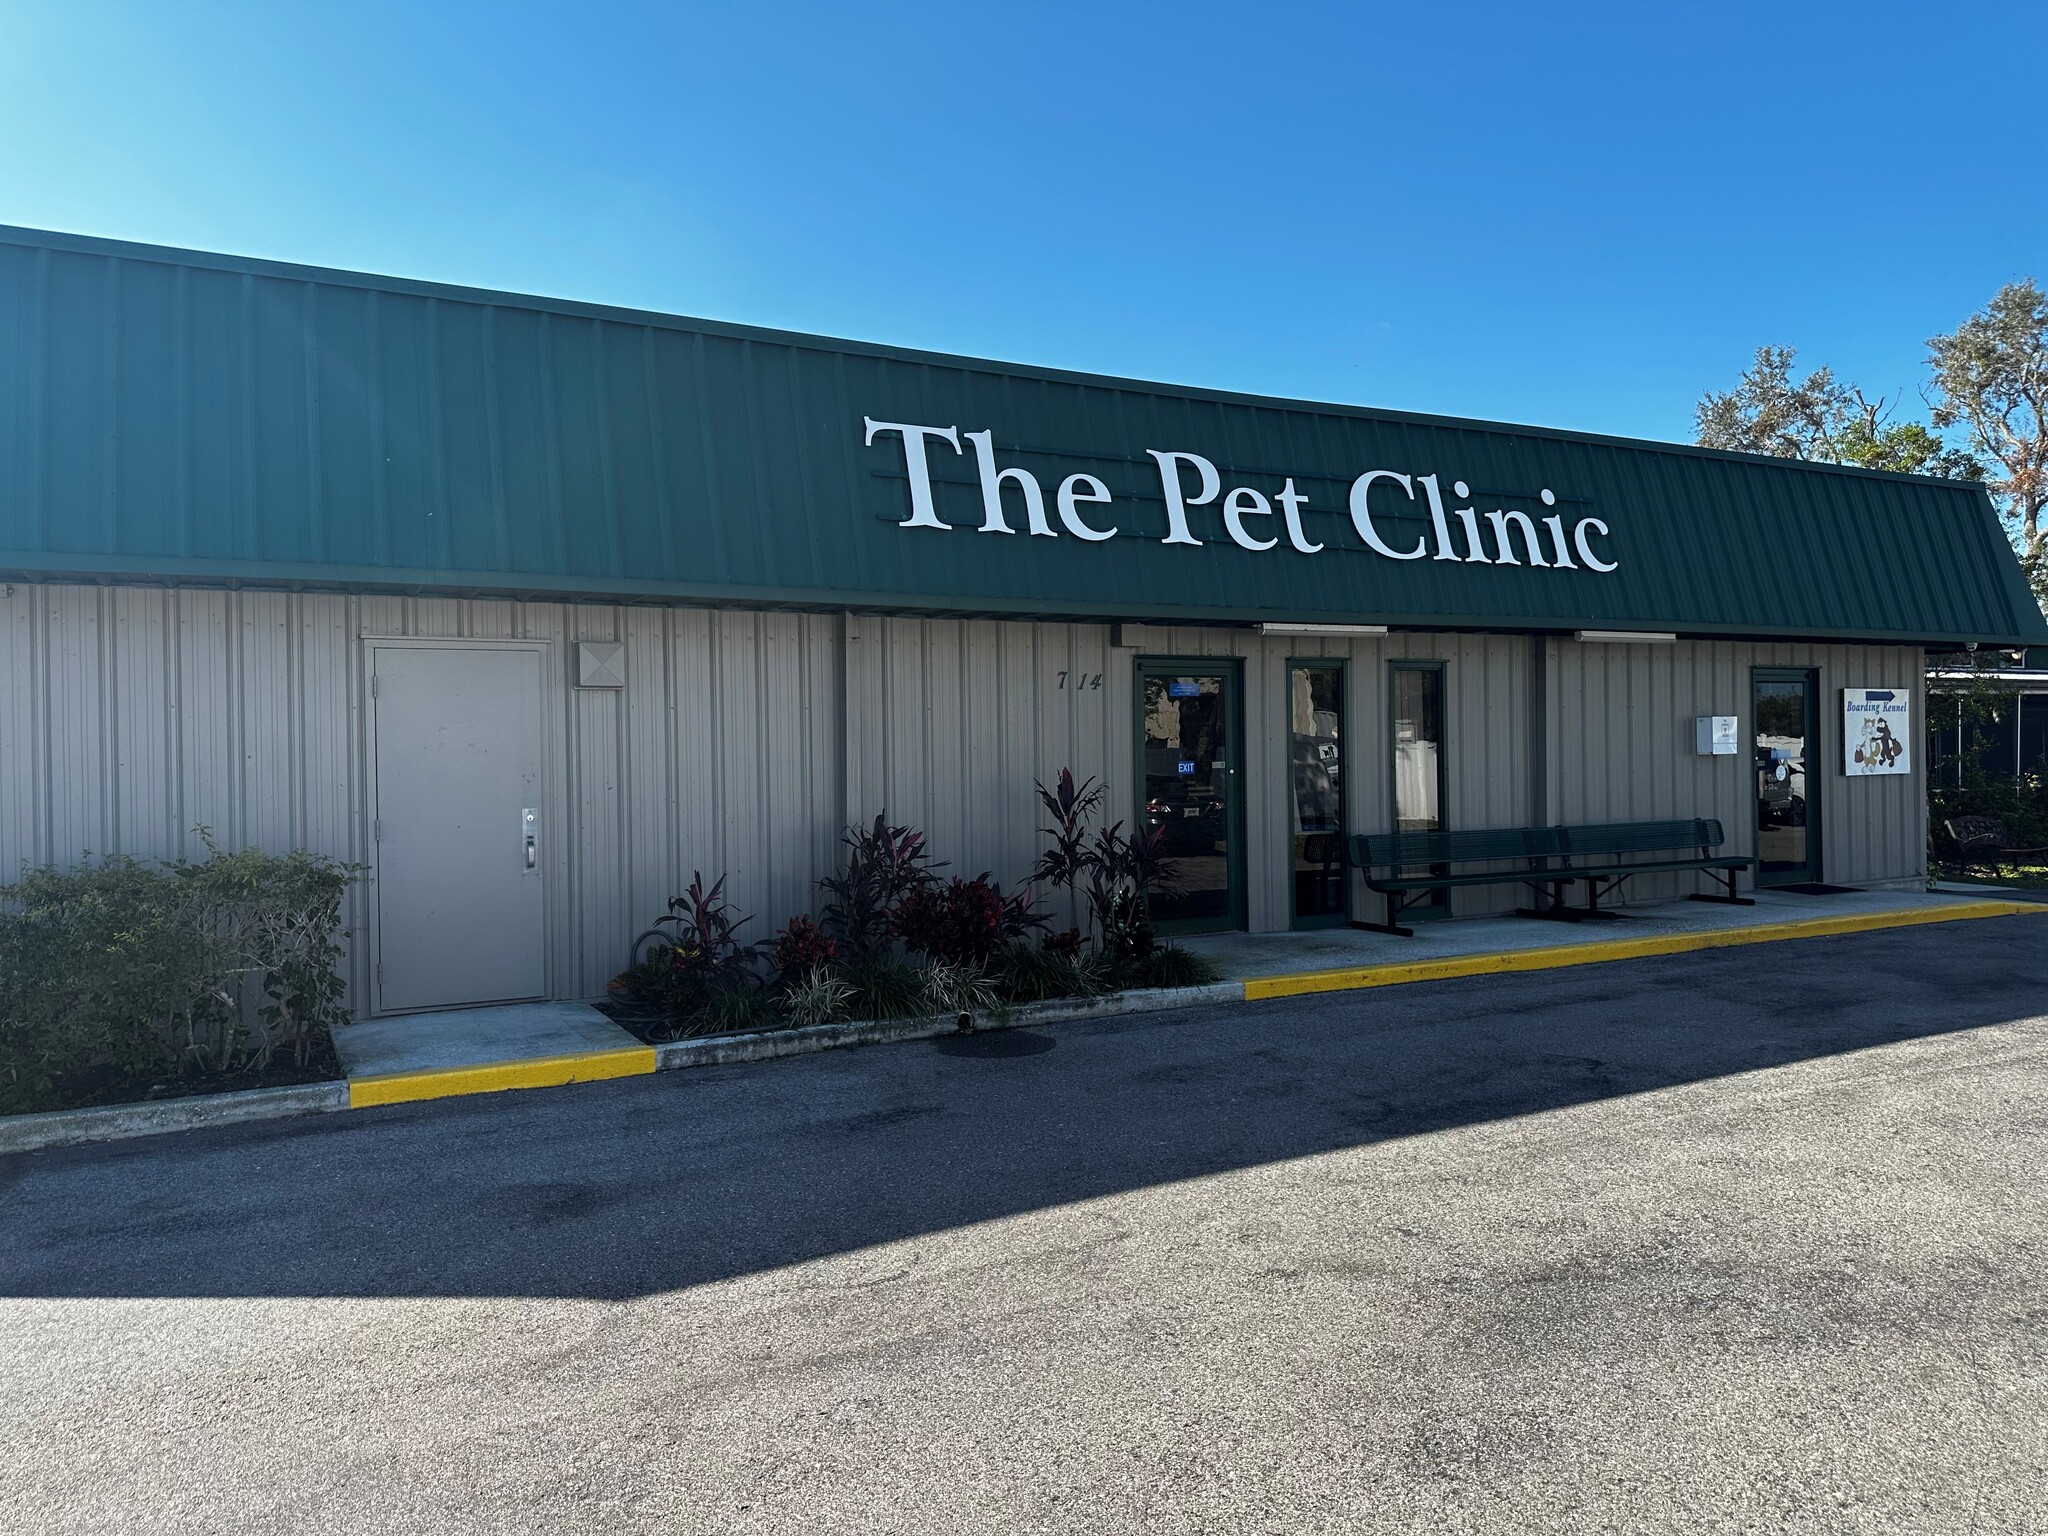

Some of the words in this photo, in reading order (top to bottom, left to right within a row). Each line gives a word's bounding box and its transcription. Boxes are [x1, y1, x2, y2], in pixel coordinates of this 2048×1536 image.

[864, 416, 1118, 541] The
[1146, 449, 1325, 554] Pet
[1349, 470, 1619, 573] Clinic
[1057, 671, 1102, 690] 714
[1846, 701, 1880, 714] Boarding
[1882, 702, 1907, 712] Kennel
[1178, 762, 1195, 773] EXIT
